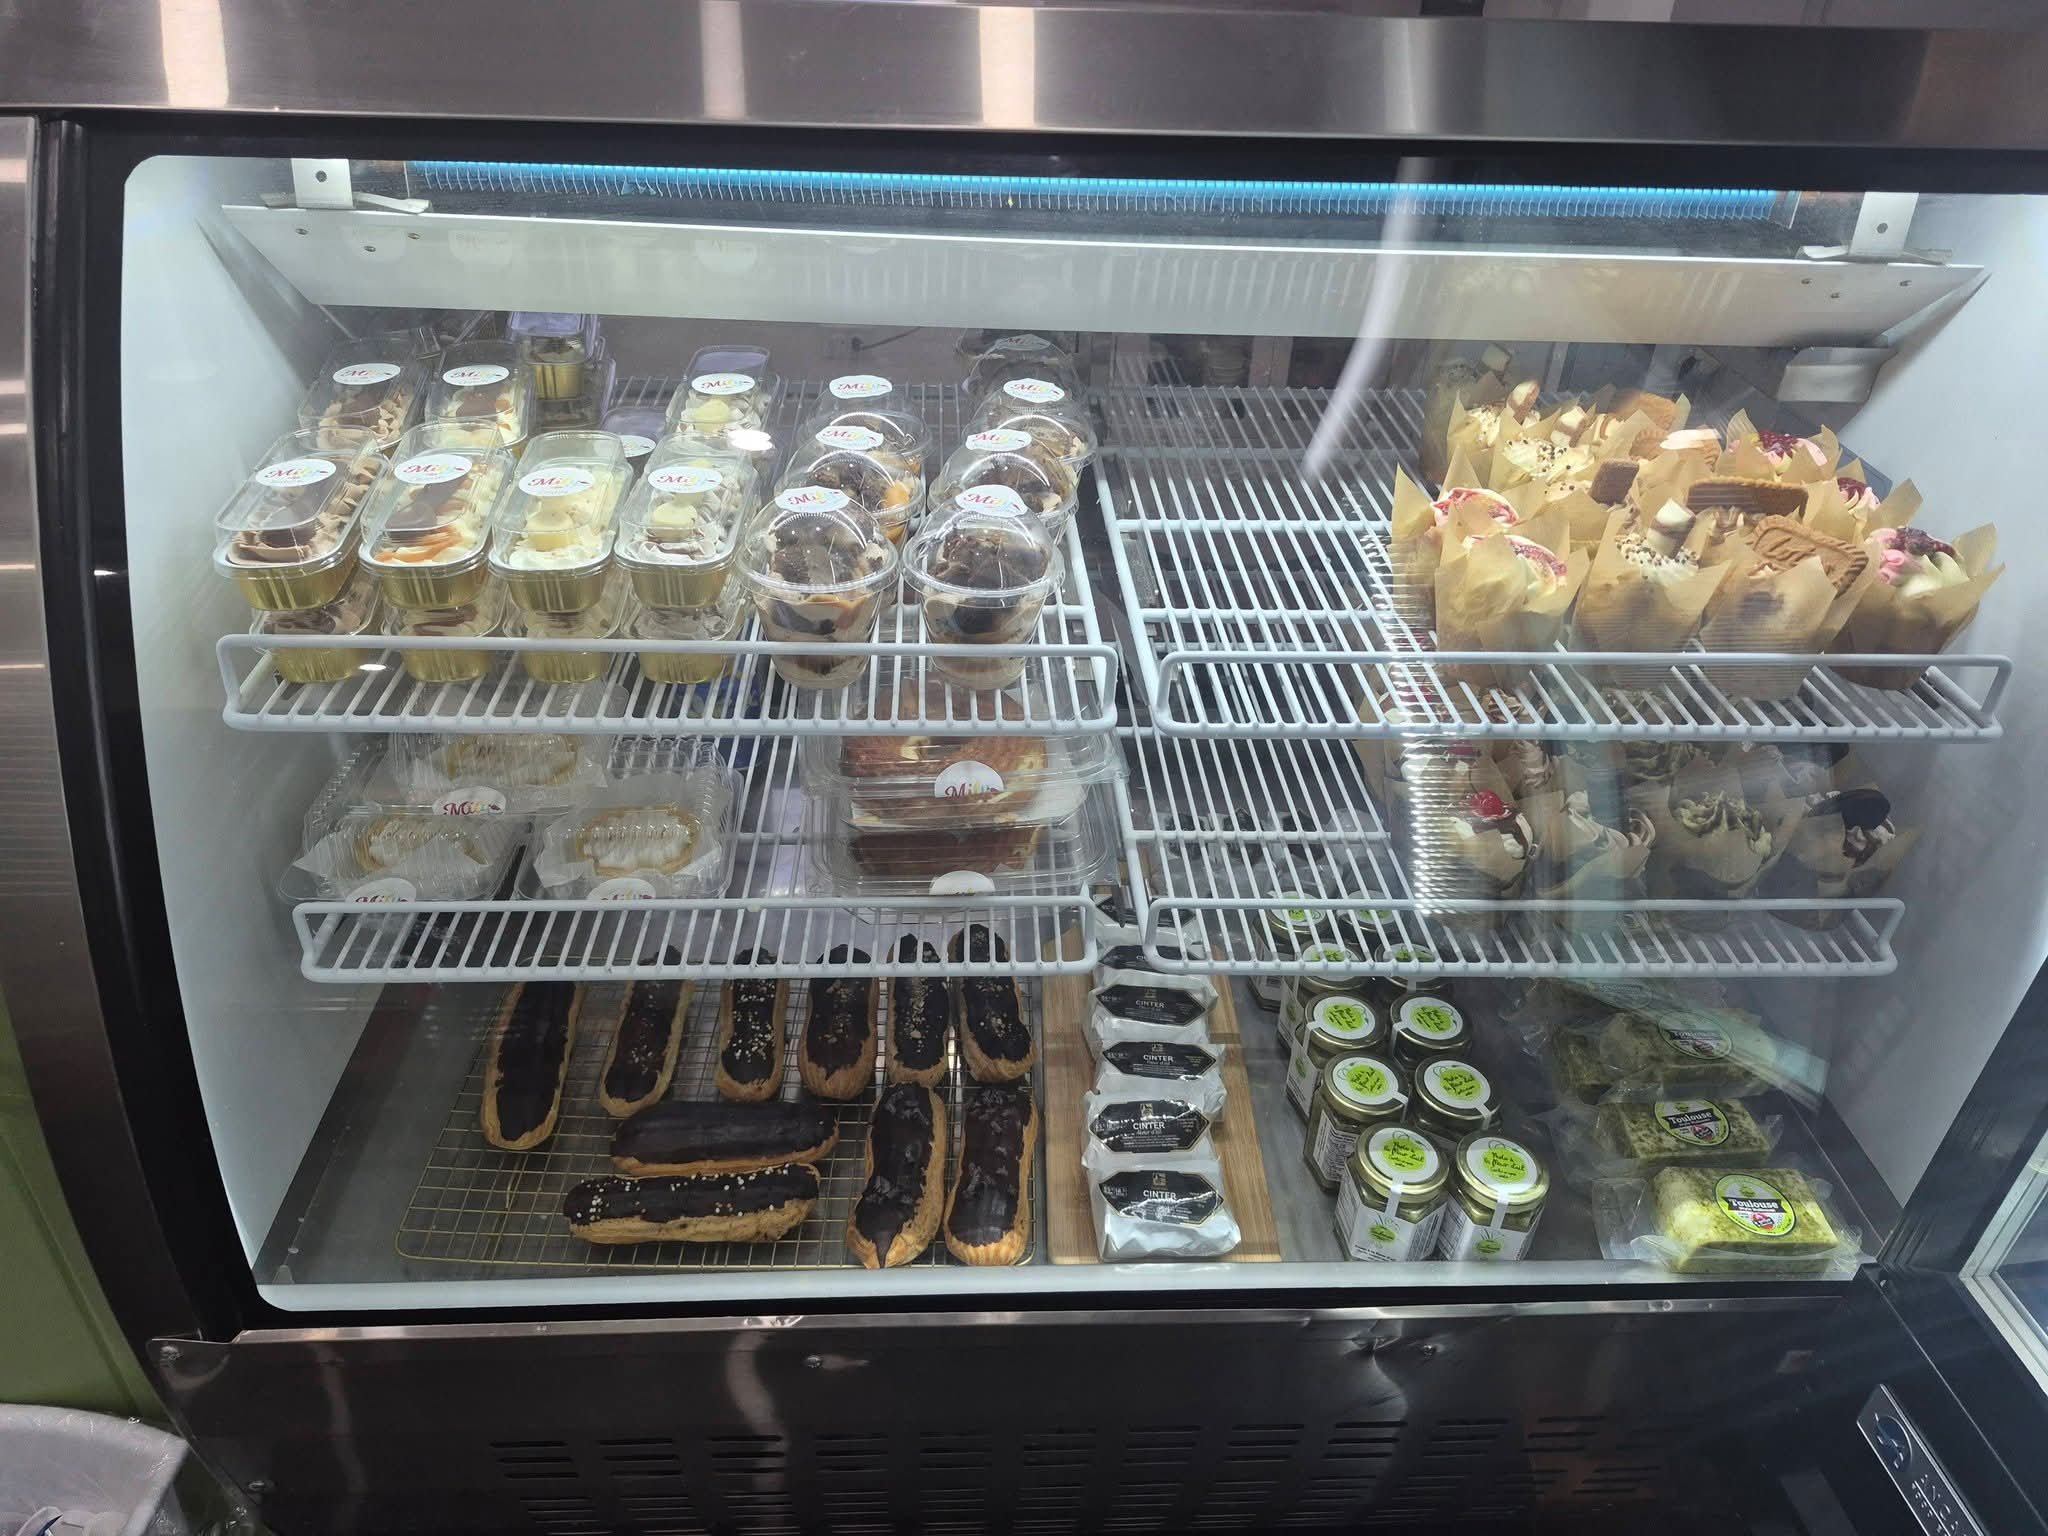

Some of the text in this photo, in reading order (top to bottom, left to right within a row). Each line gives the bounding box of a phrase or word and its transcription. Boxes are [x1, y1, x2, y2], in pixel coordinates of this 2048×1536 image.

[1135, 1000, 1165, 1009] CINTER
[1143, 1054, 1174, 1063] CINTER
[1668, 1112, 1713, 1125] Toulouse
[1133, 1121, 1166, 1130] CINTER
[1143, 1190, 1177, 1200] CINTER
[1728, 1199, 1779, 1209] Toulouse
